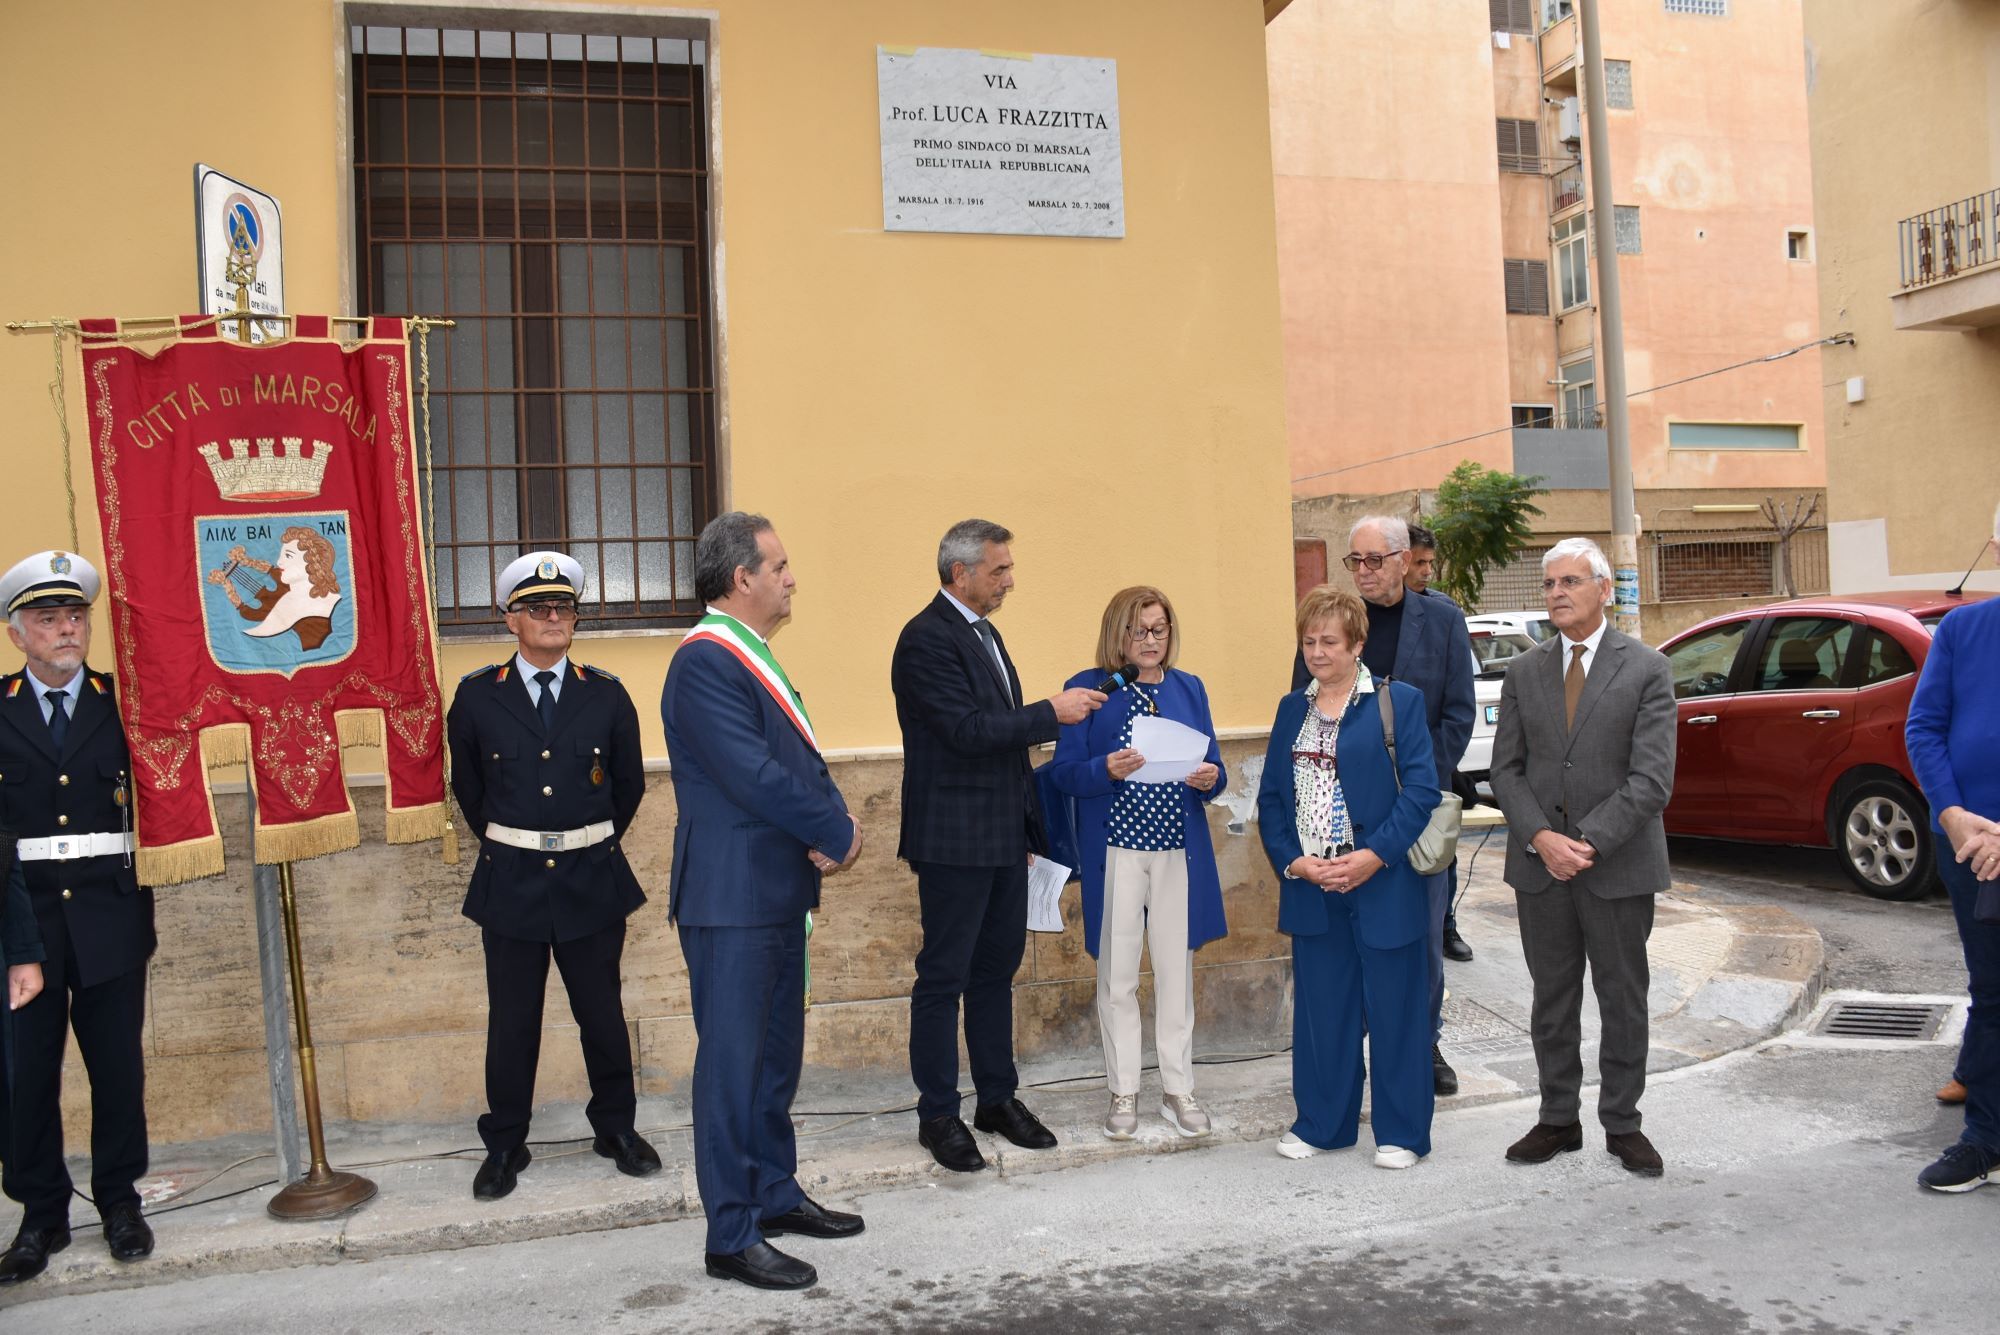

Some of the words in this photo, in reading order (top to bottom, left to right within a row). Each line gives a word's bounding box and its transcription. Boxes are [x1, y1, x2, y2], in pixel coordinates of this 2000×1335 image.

[984, 74, 1018, 90] VIA
[892, 106, 927, 121] Prof.
[933, 105, 989, 124] LUCA
[998, 108, 1108, 130] FRAZZITTA
[914, 139, 953, 150] PRIMO
[957, 140, 1011, 153] SINDACO
[1016, 143, 1029, 153] DI
[1034, 144, 1091, 156] MARSALA
[1000, 161, 1091, 174] REPUBBLICANA
[898, 196, 939, 205] MARSALA
[1028, 200, 1068, 209] MARSALA
[254, 281, 267, 296] lati
[215, 287, 223, 298] da
[250, 300, 260, 310] ore
[219, 387, 241, 407] DI
[254, 373, 378, 445] MARSALA
